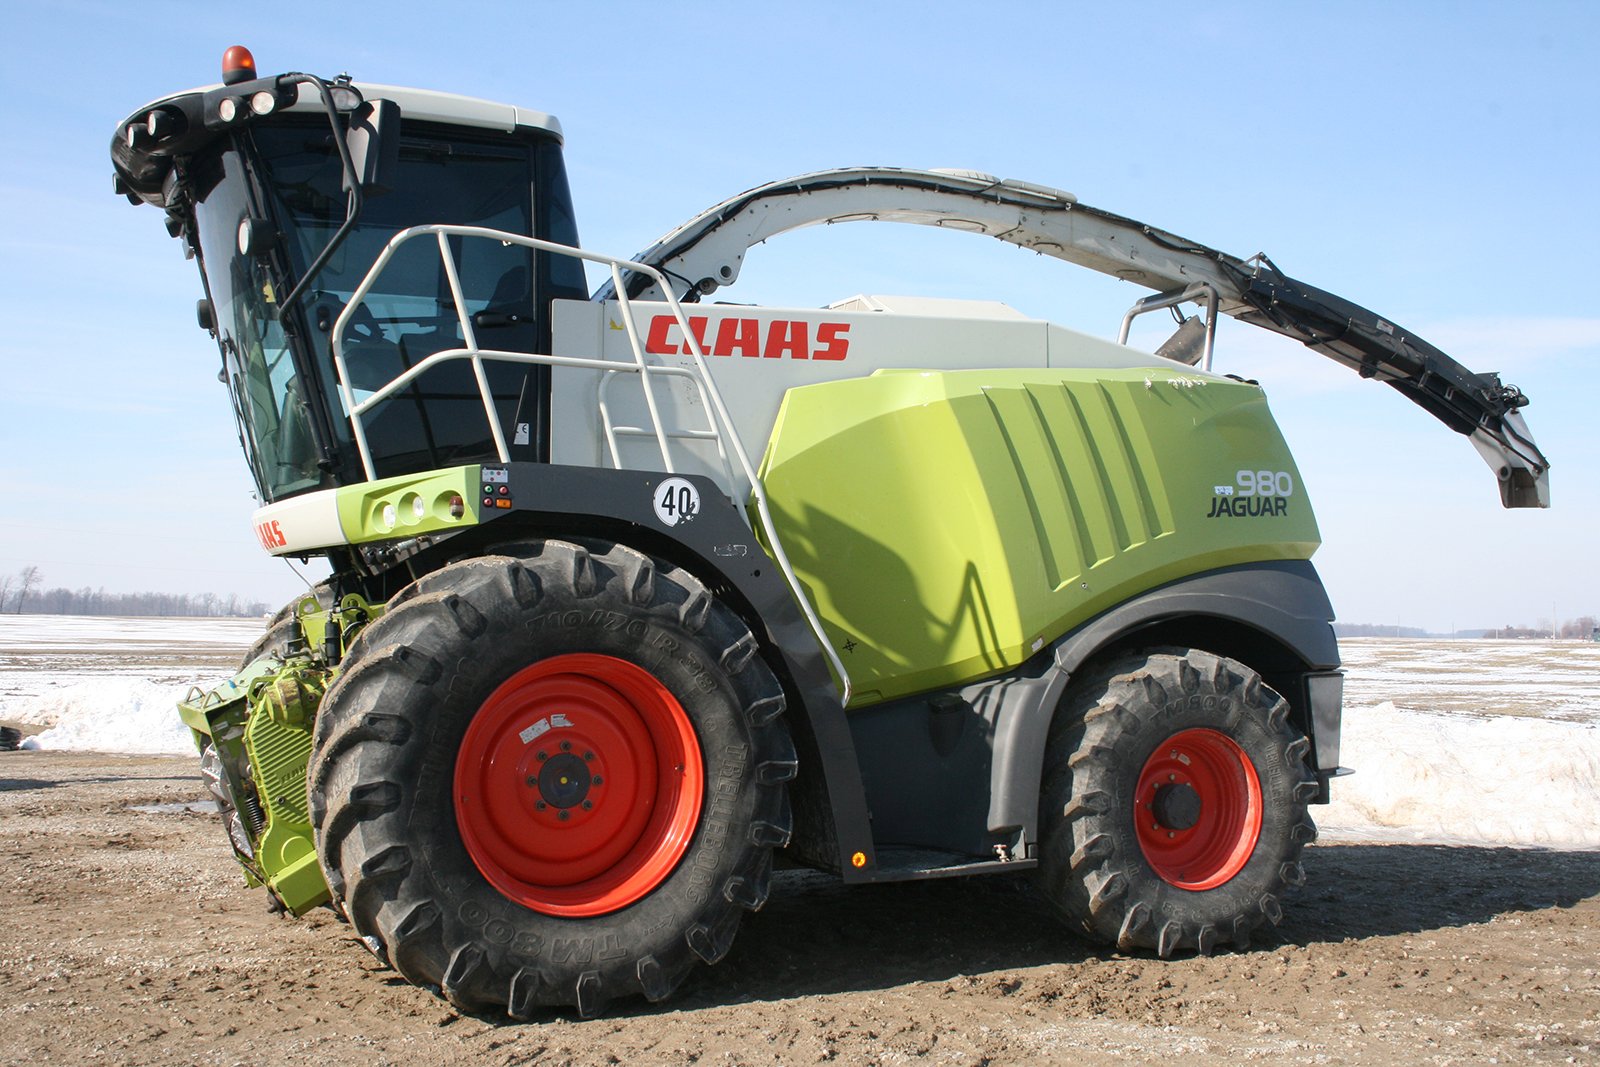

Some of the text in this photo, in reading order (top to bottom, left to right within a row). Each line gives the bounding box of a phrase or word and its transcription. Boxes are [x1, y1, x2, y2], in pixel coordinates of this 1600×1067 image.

[645, 315, 851, 361] CLAAS
[661, 486, 692, 516] 40
[1236, 470, 1293, 497] 980
[1207, 497, 1287, 518] JAGUAR
[525, 608, 719, 695] 710/70 R 38
[685, 743, 749, 906] TRELLEBORG
